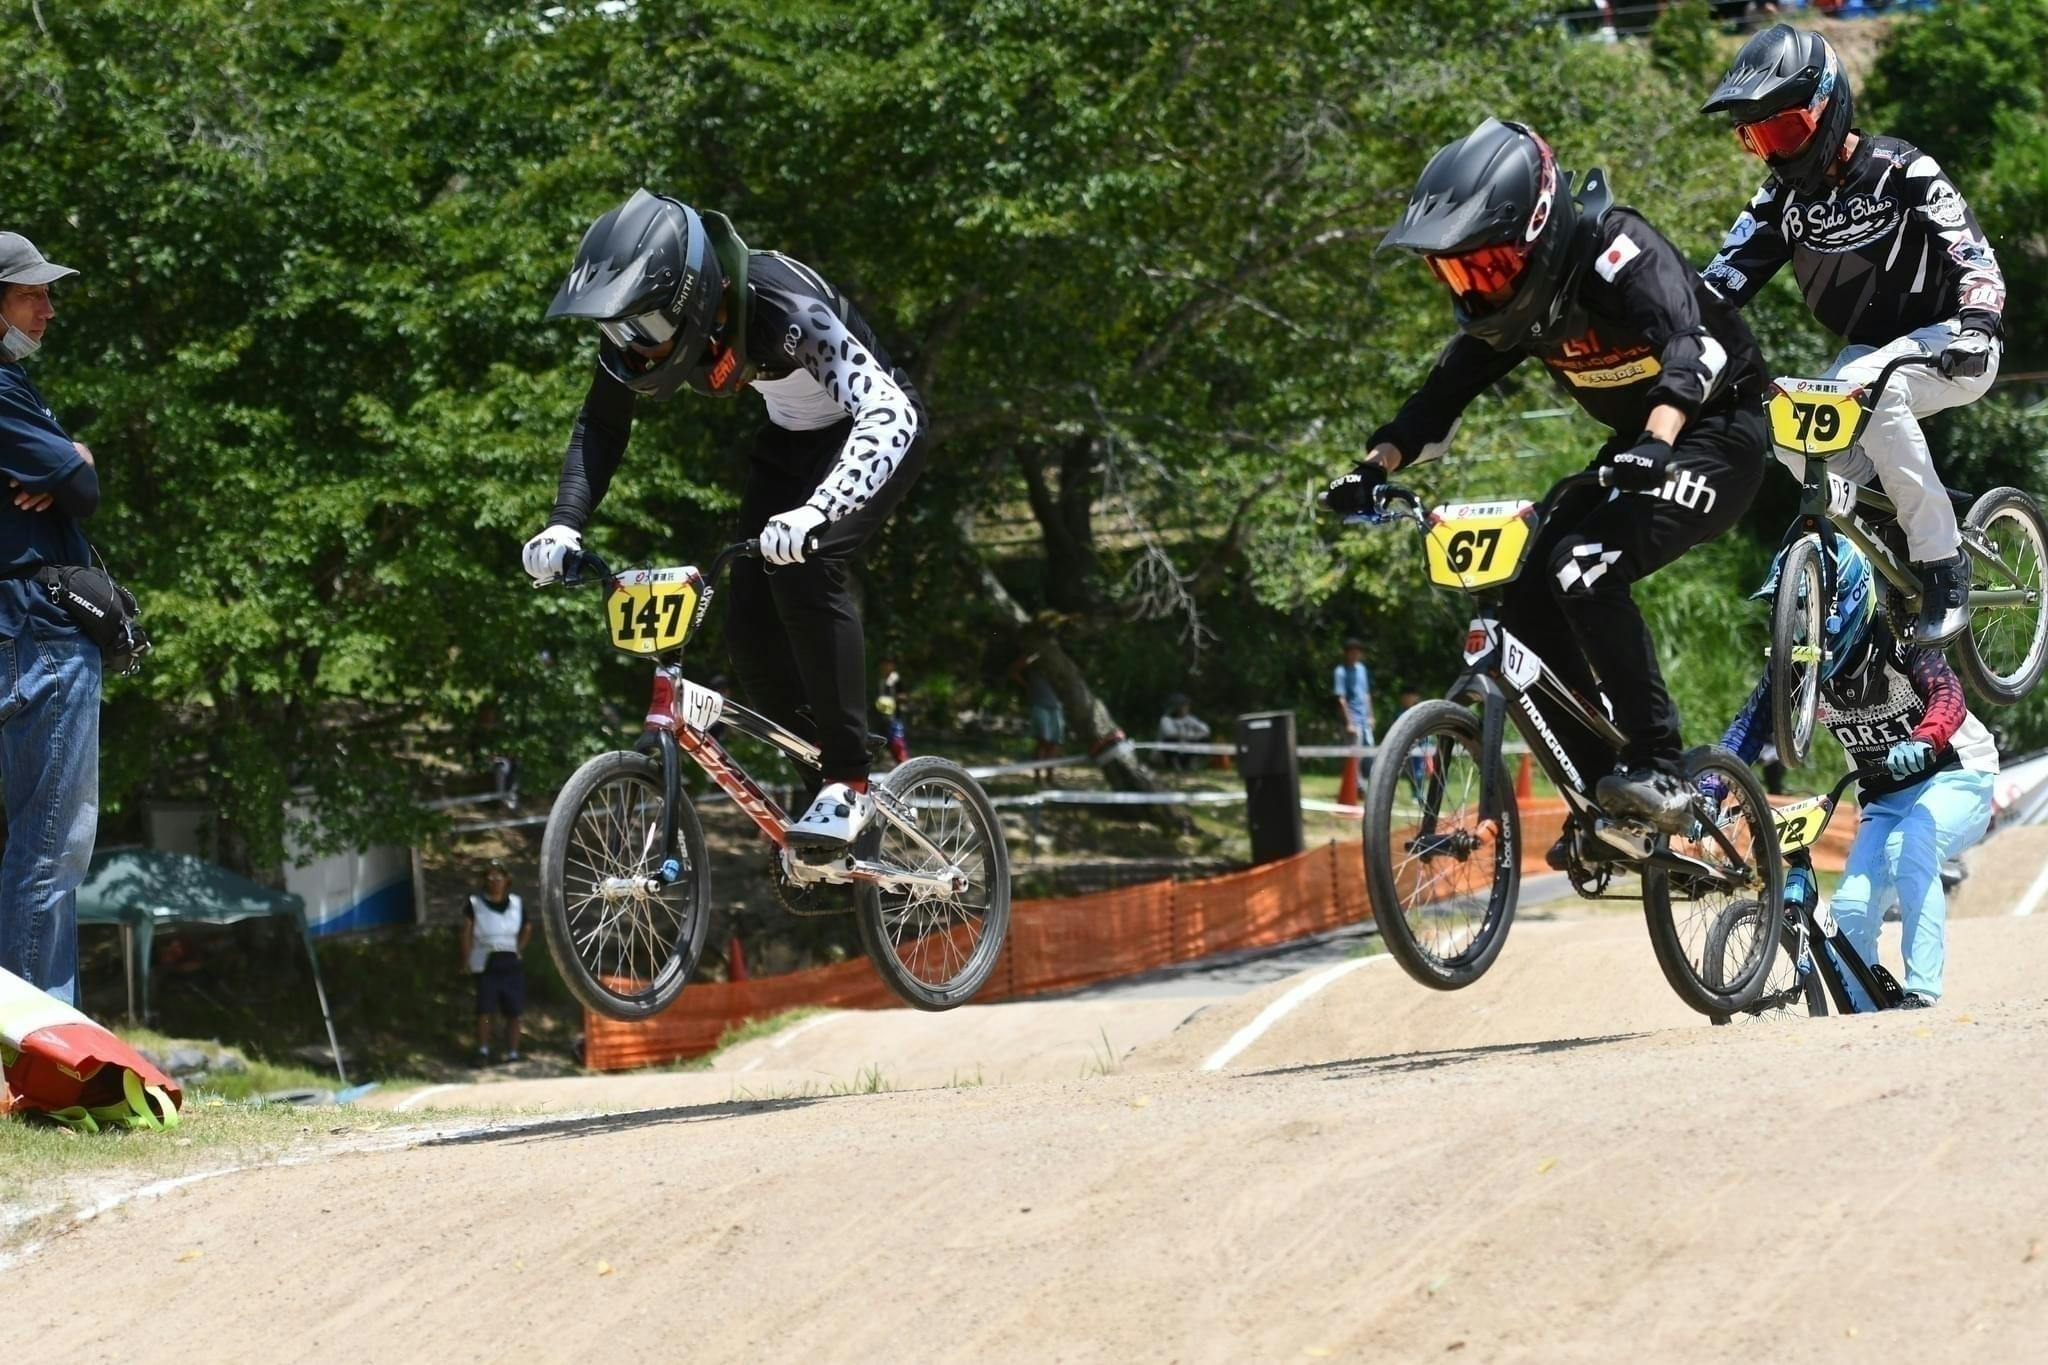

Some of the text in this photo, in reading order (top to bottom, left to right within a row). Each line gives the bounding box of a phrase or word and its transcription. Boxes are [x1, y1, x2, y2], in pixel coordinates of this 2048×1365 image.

[1785, 206, 1804, 239] B
[1807, 203, 1847, 234] Side
[1848, 196, 1892, 221] Bikes
[672, 274, 694, 315] SMITH
[1806, 384, 1839, 394] 大東建託
[1793, 402, 1841, 442] 79
[1832, 479, 1850, 512] 79
[1447, 528, 1503, 574] 67
[1853, 557, 1872, 602] OAKLE
[68, 591, 105, 618] TAICHI
[618, 593, 685, 641] 147
[1508, 644, 1524, 675] 67
[1519, 692, 1587, 793] MONGOOSE
[1776, 816, 1807, 845] 72
[1501, 841, 1512, 868] box
